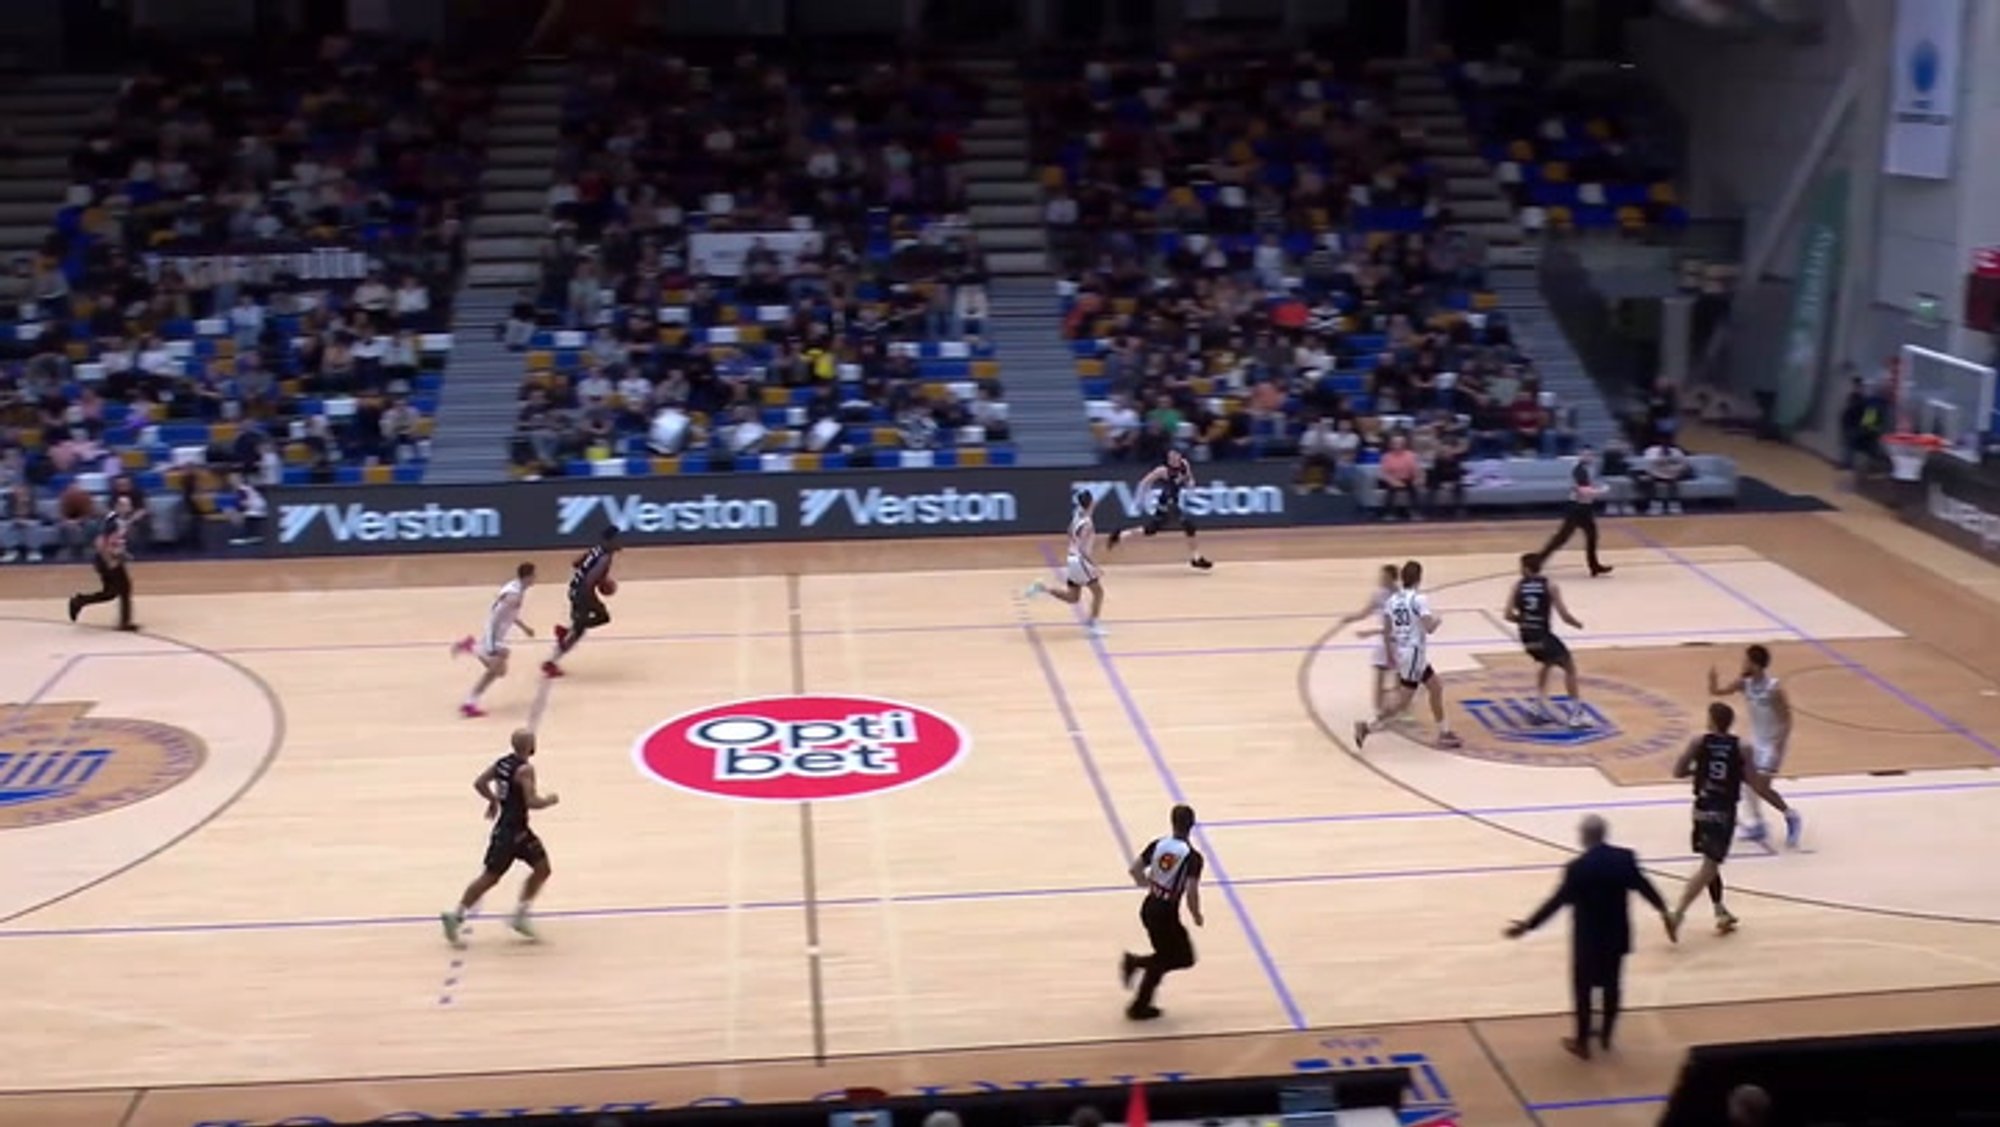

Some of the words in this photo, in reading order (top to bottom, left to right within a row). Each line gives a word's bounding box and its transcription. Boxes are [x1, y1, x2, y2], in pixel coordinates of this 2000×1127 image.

[323, 503, 500, 541] Verston
[602, 494, 775, 532] Verston
[843, 488, 1017, 525] Verston
[697, 711, 907, 749] Opti
[725, 745, 887, 775] bet
